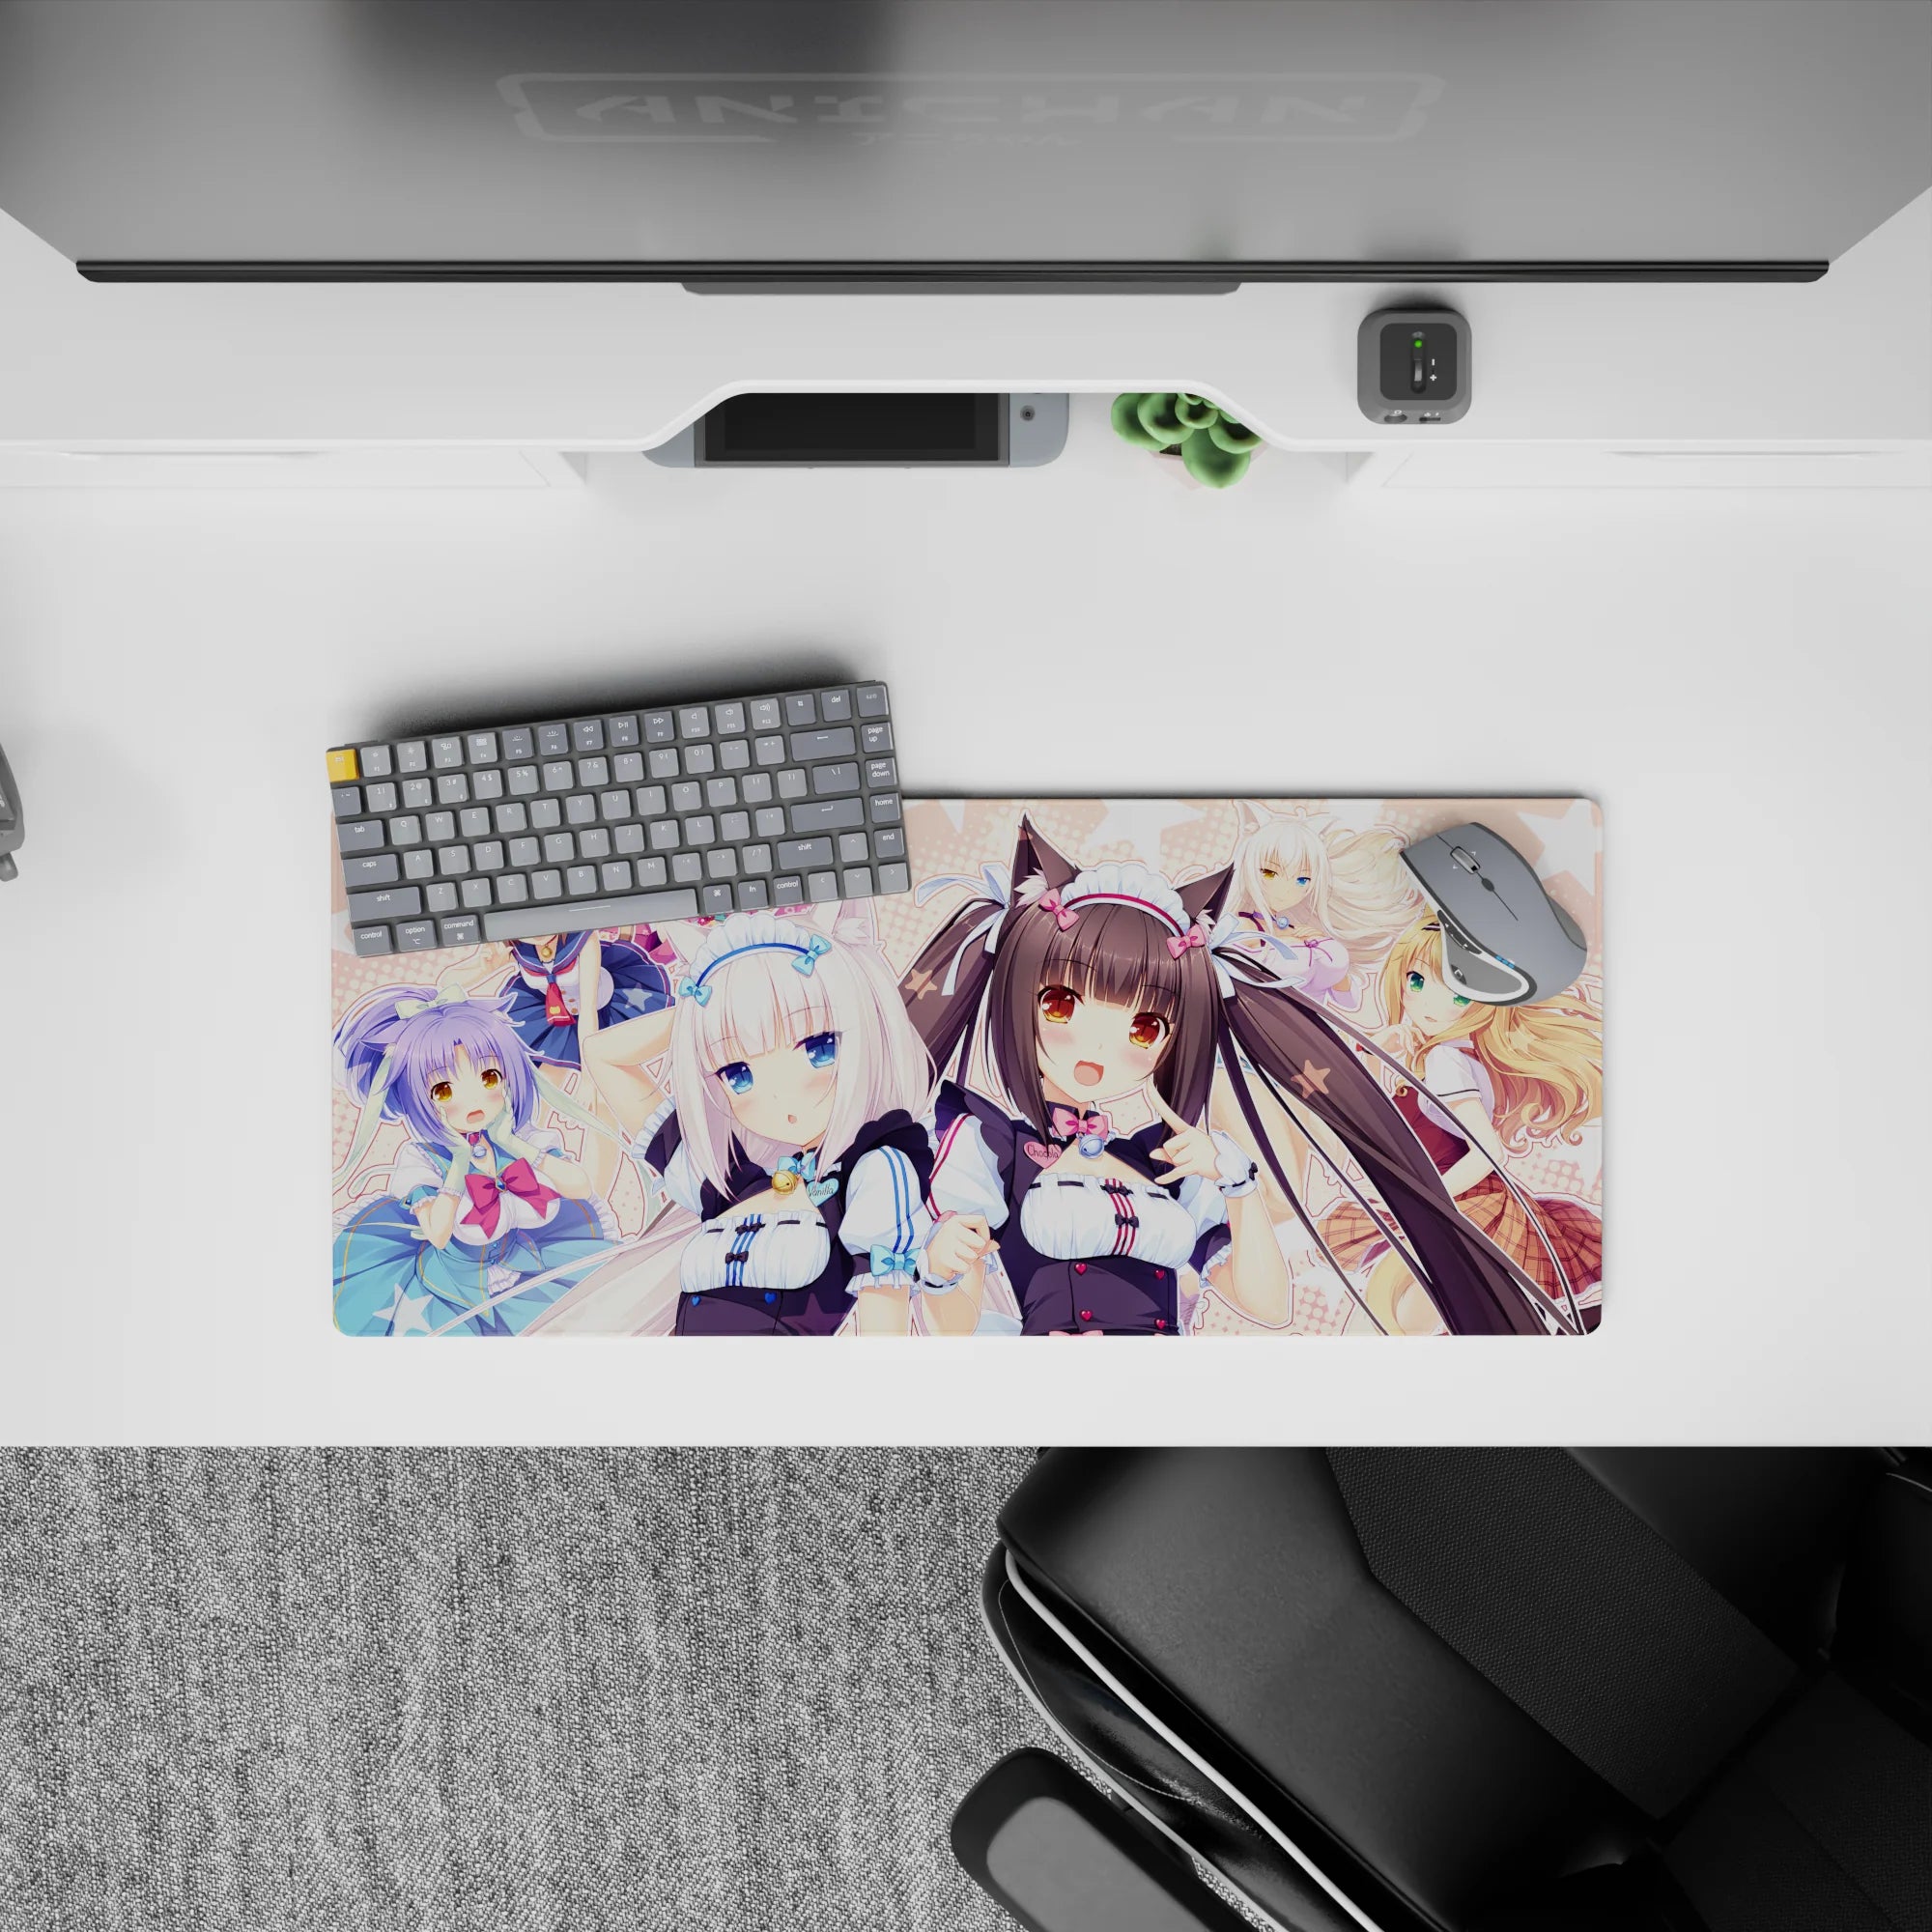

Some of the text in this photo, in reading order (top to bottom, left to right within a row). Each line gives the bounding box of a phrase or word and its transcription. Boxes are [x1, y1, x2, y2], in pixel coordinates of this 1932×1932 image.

[575, 95, 1365, 124] ANICHAN
[867, 725, 883, 734] page
[870, 762, 887, 771] page
[871, 770, 891, 779] down
[542, 803, 549, 811] T
[354, 825, 365, 834] tab
[797, 842, 812, 851] shift
[362, 860, 378, 869] caps
[776, 880, 799, 890] control
[376, 894, 391, 902] shift
[443, 920, 474, 929] command
[360, 930, 383, 940] control
[405, 926, 426, 935] option
